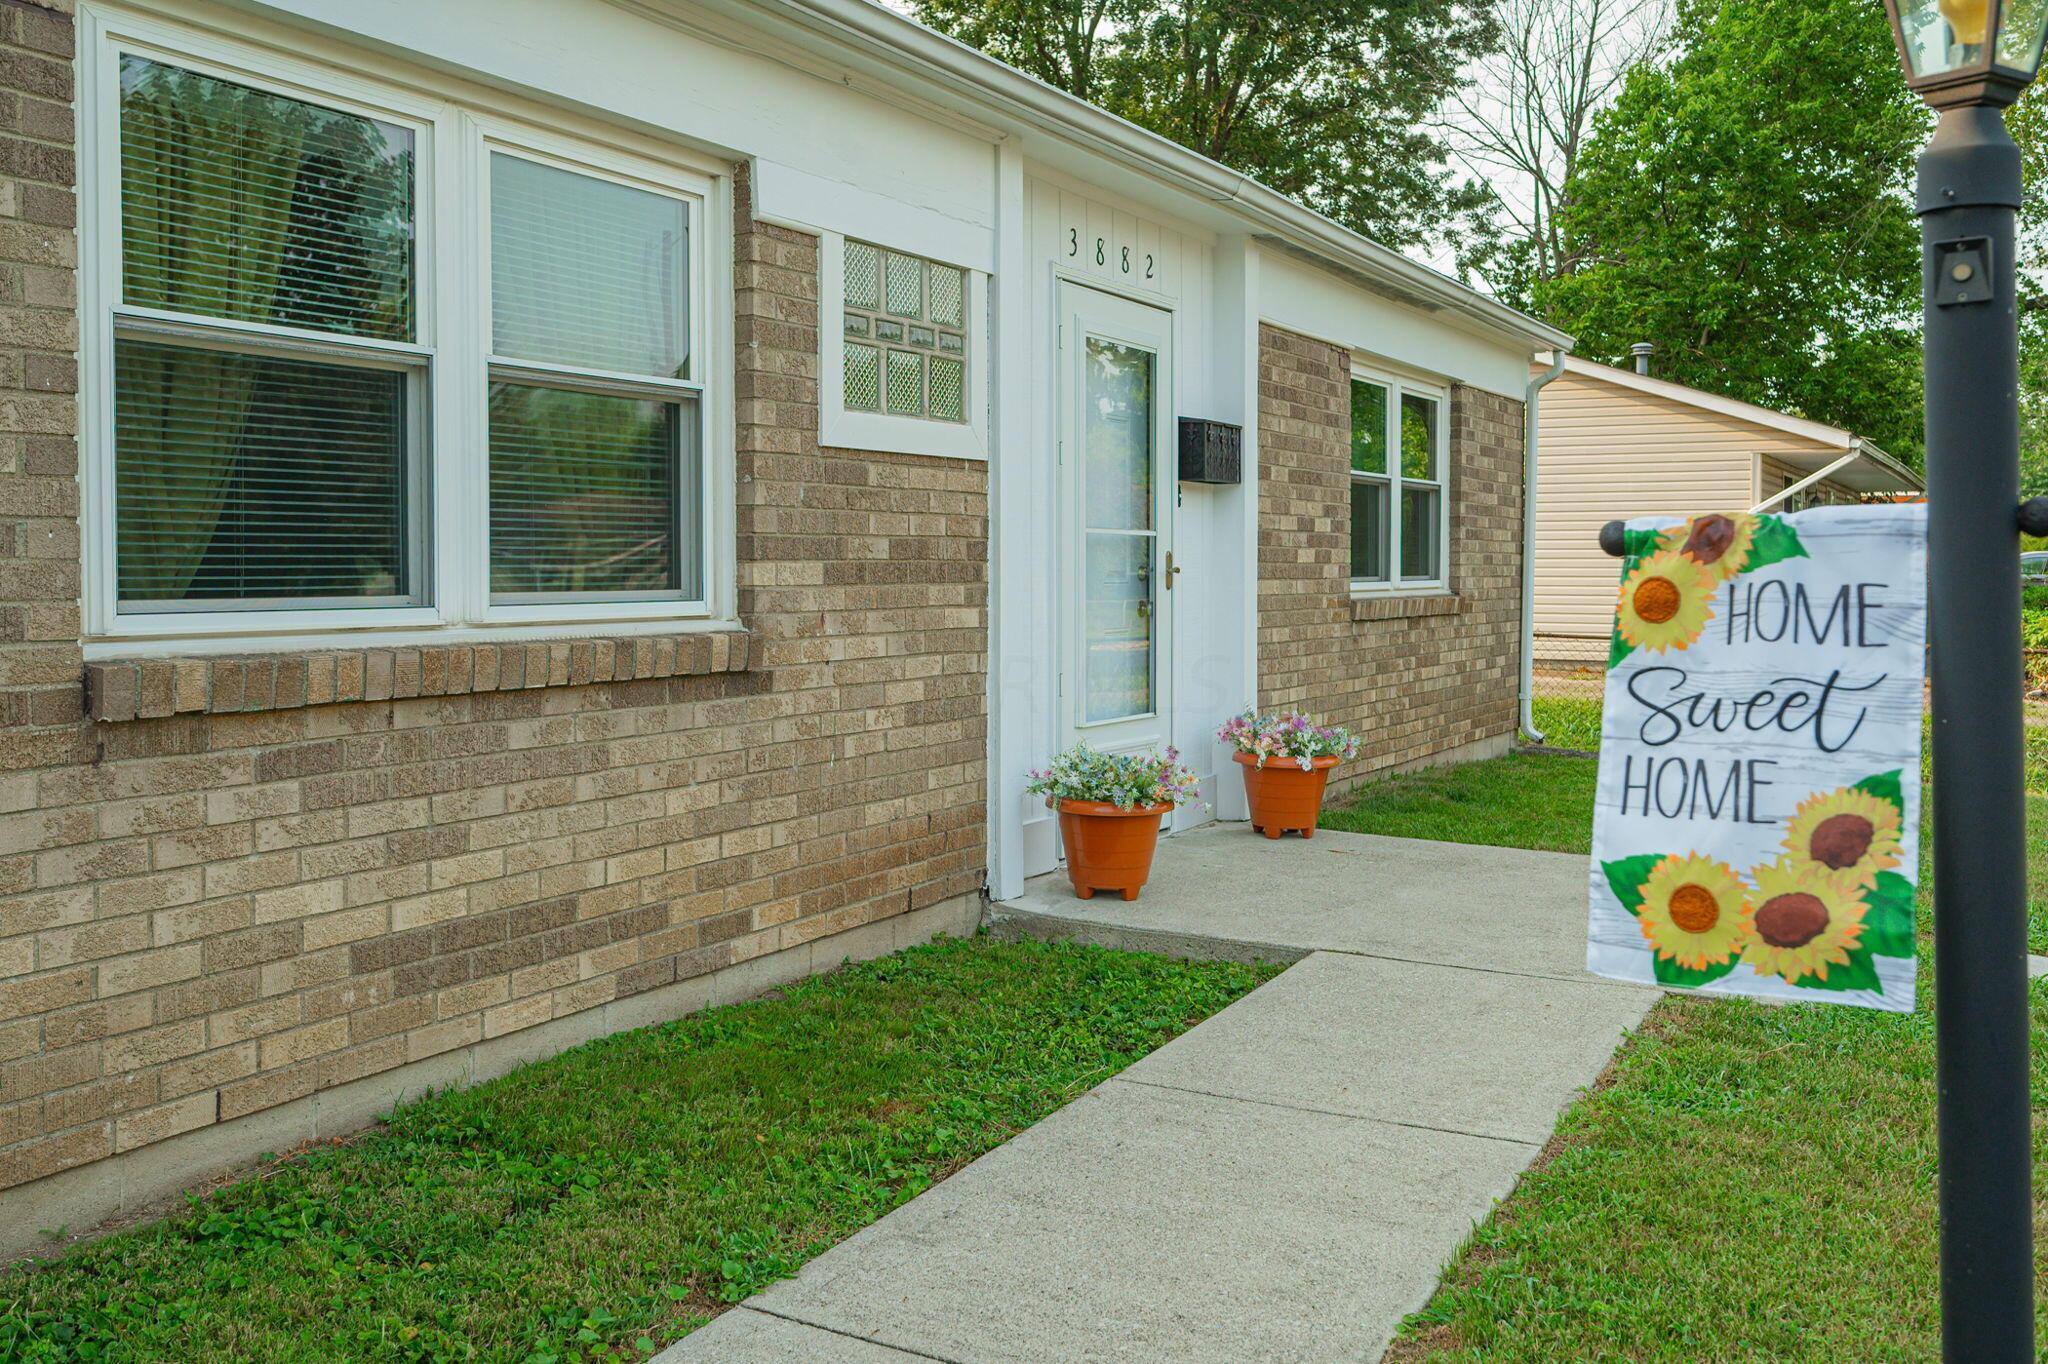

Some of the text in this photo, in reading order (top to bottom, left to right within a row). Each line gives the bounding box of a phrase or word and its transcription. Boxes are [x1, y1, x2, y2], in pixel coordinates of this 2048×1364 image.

[1069, 228, 1153, 279] 3882
[1727, 579, 1889, 648] HOME
[1627, 666, 1888, 753] Sweet
[1620, 754, 1778, 824] HOME
